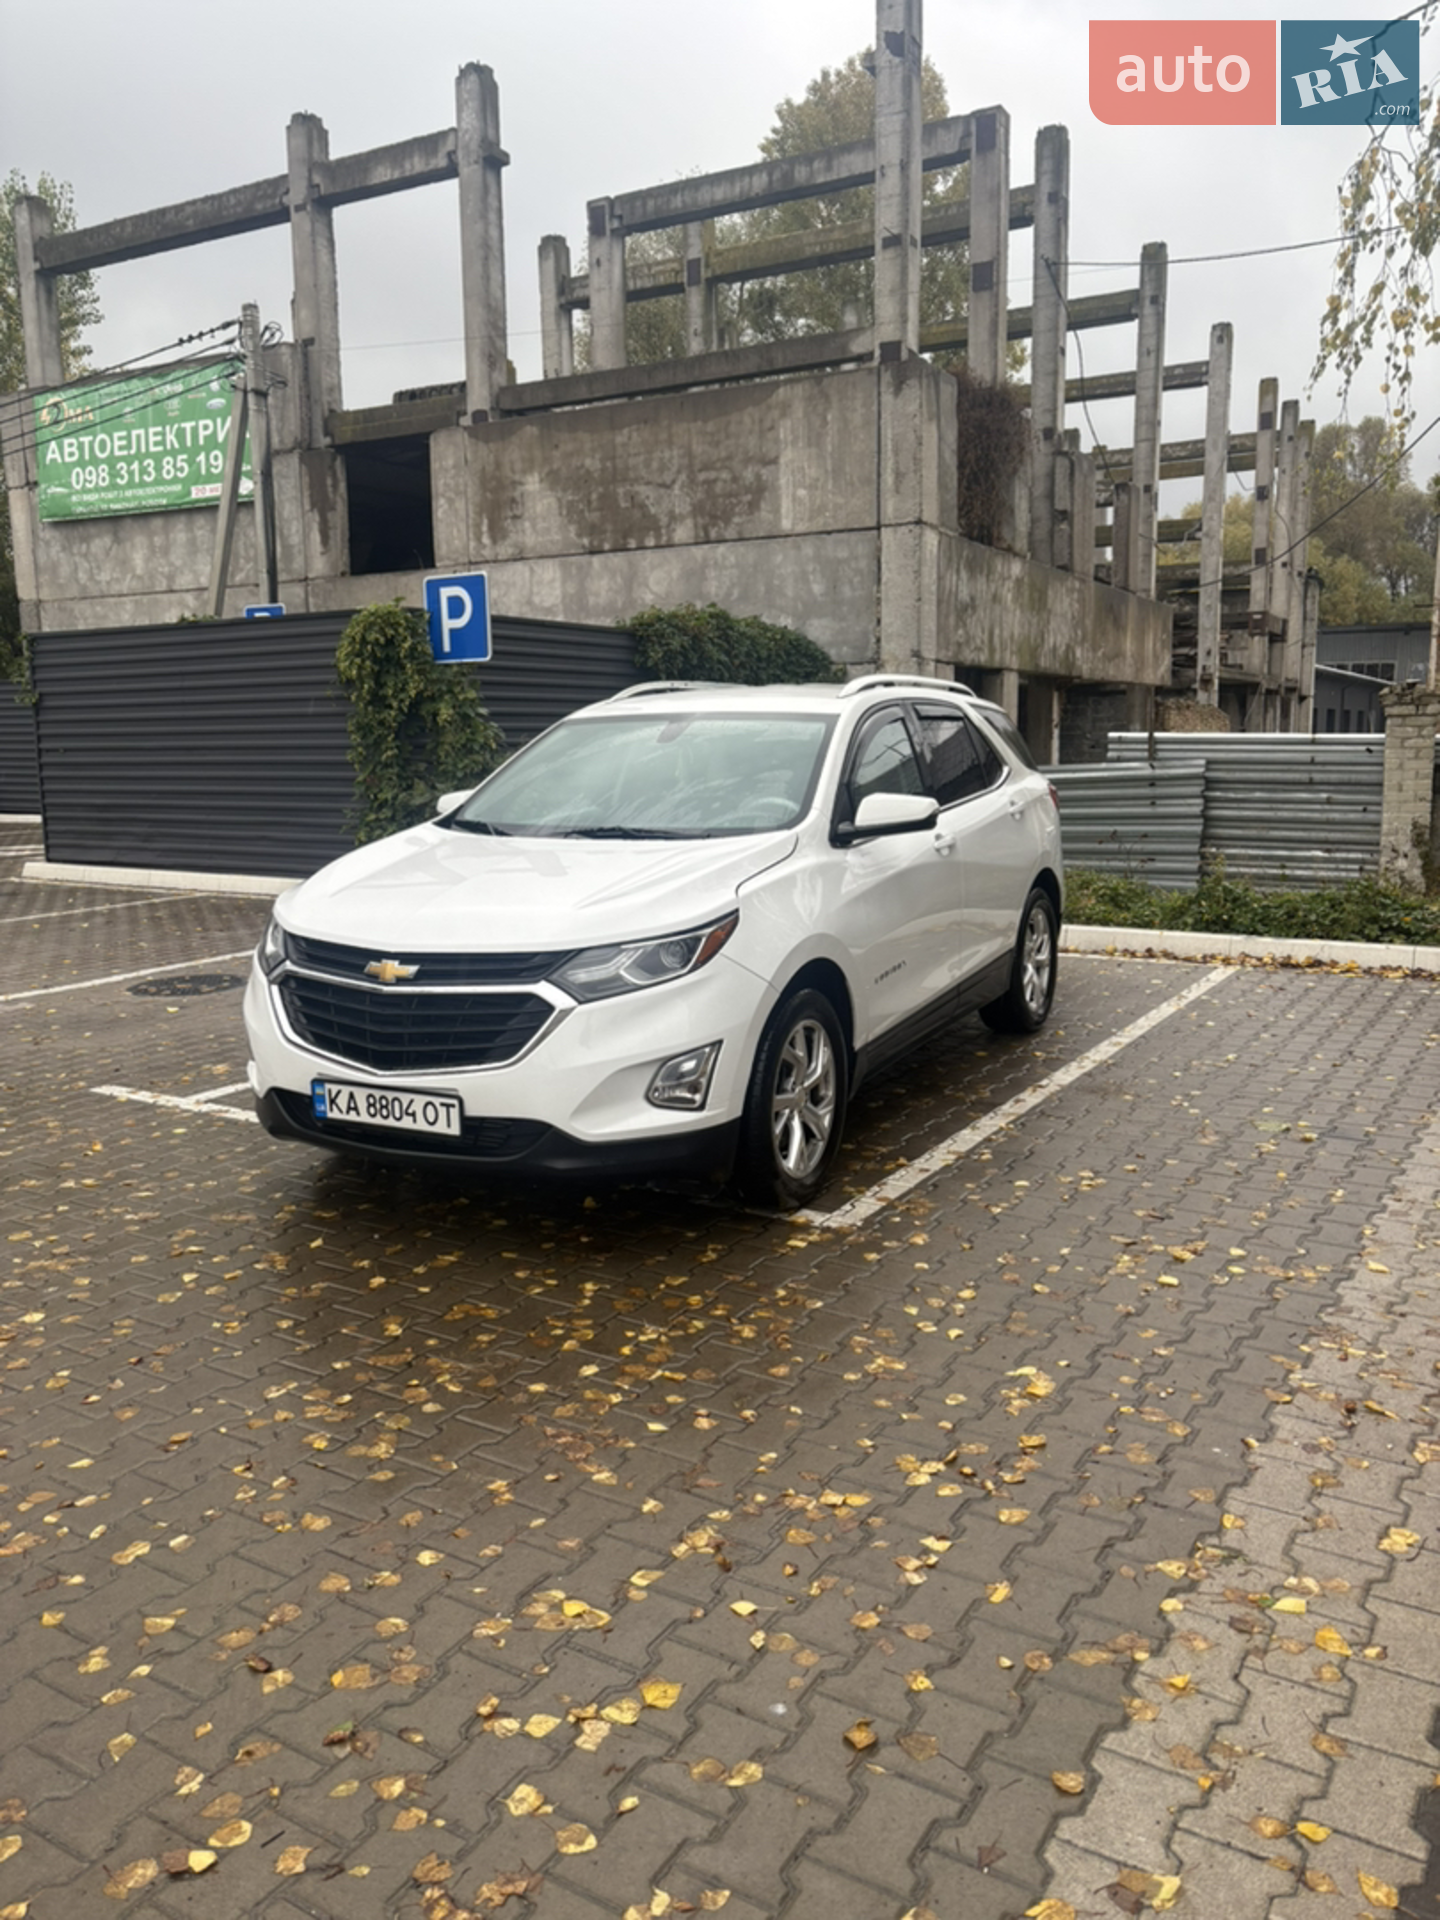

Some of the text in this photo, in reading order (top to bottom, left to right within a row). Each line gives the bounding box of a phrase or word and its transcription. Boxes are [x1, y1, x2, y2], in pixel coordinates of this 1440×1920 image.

[46, 415, 249, 464] АВТОЕЛЕКТРИ
[71, 450, 224, 490] 098 313 85 19
[439, 586, 473, 653] P
[328, 1087, 456, 1129] KA 8804 OT
